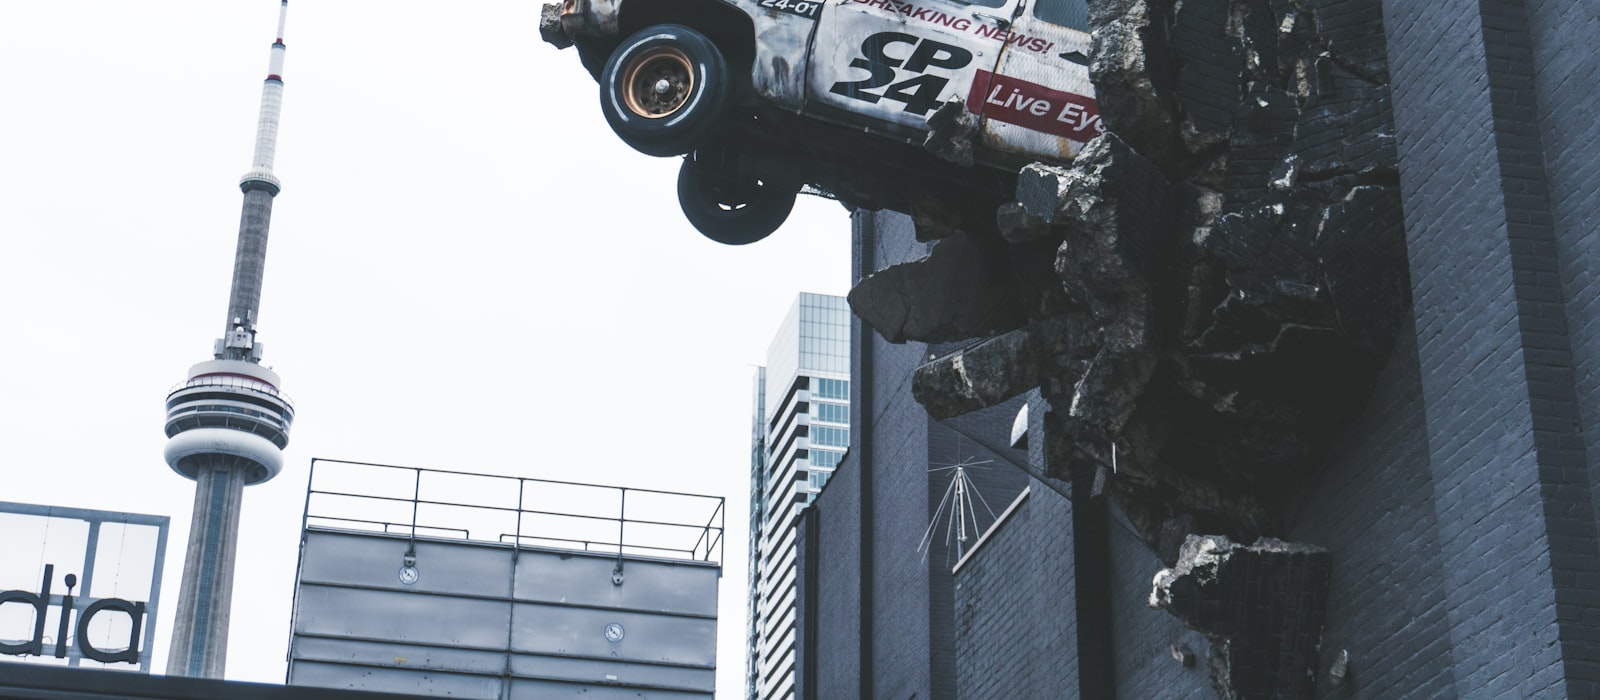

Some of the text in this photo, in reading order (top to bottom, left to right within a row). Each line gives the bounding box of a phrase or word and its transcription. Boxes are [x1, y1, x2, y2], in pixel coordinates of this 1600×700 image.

[861, 31, 973, 74] CP
[975, 24, 1054, 54] NEWS!
[829, 57, 946, 116] 24
[987, 84, 1051, 117] Live
